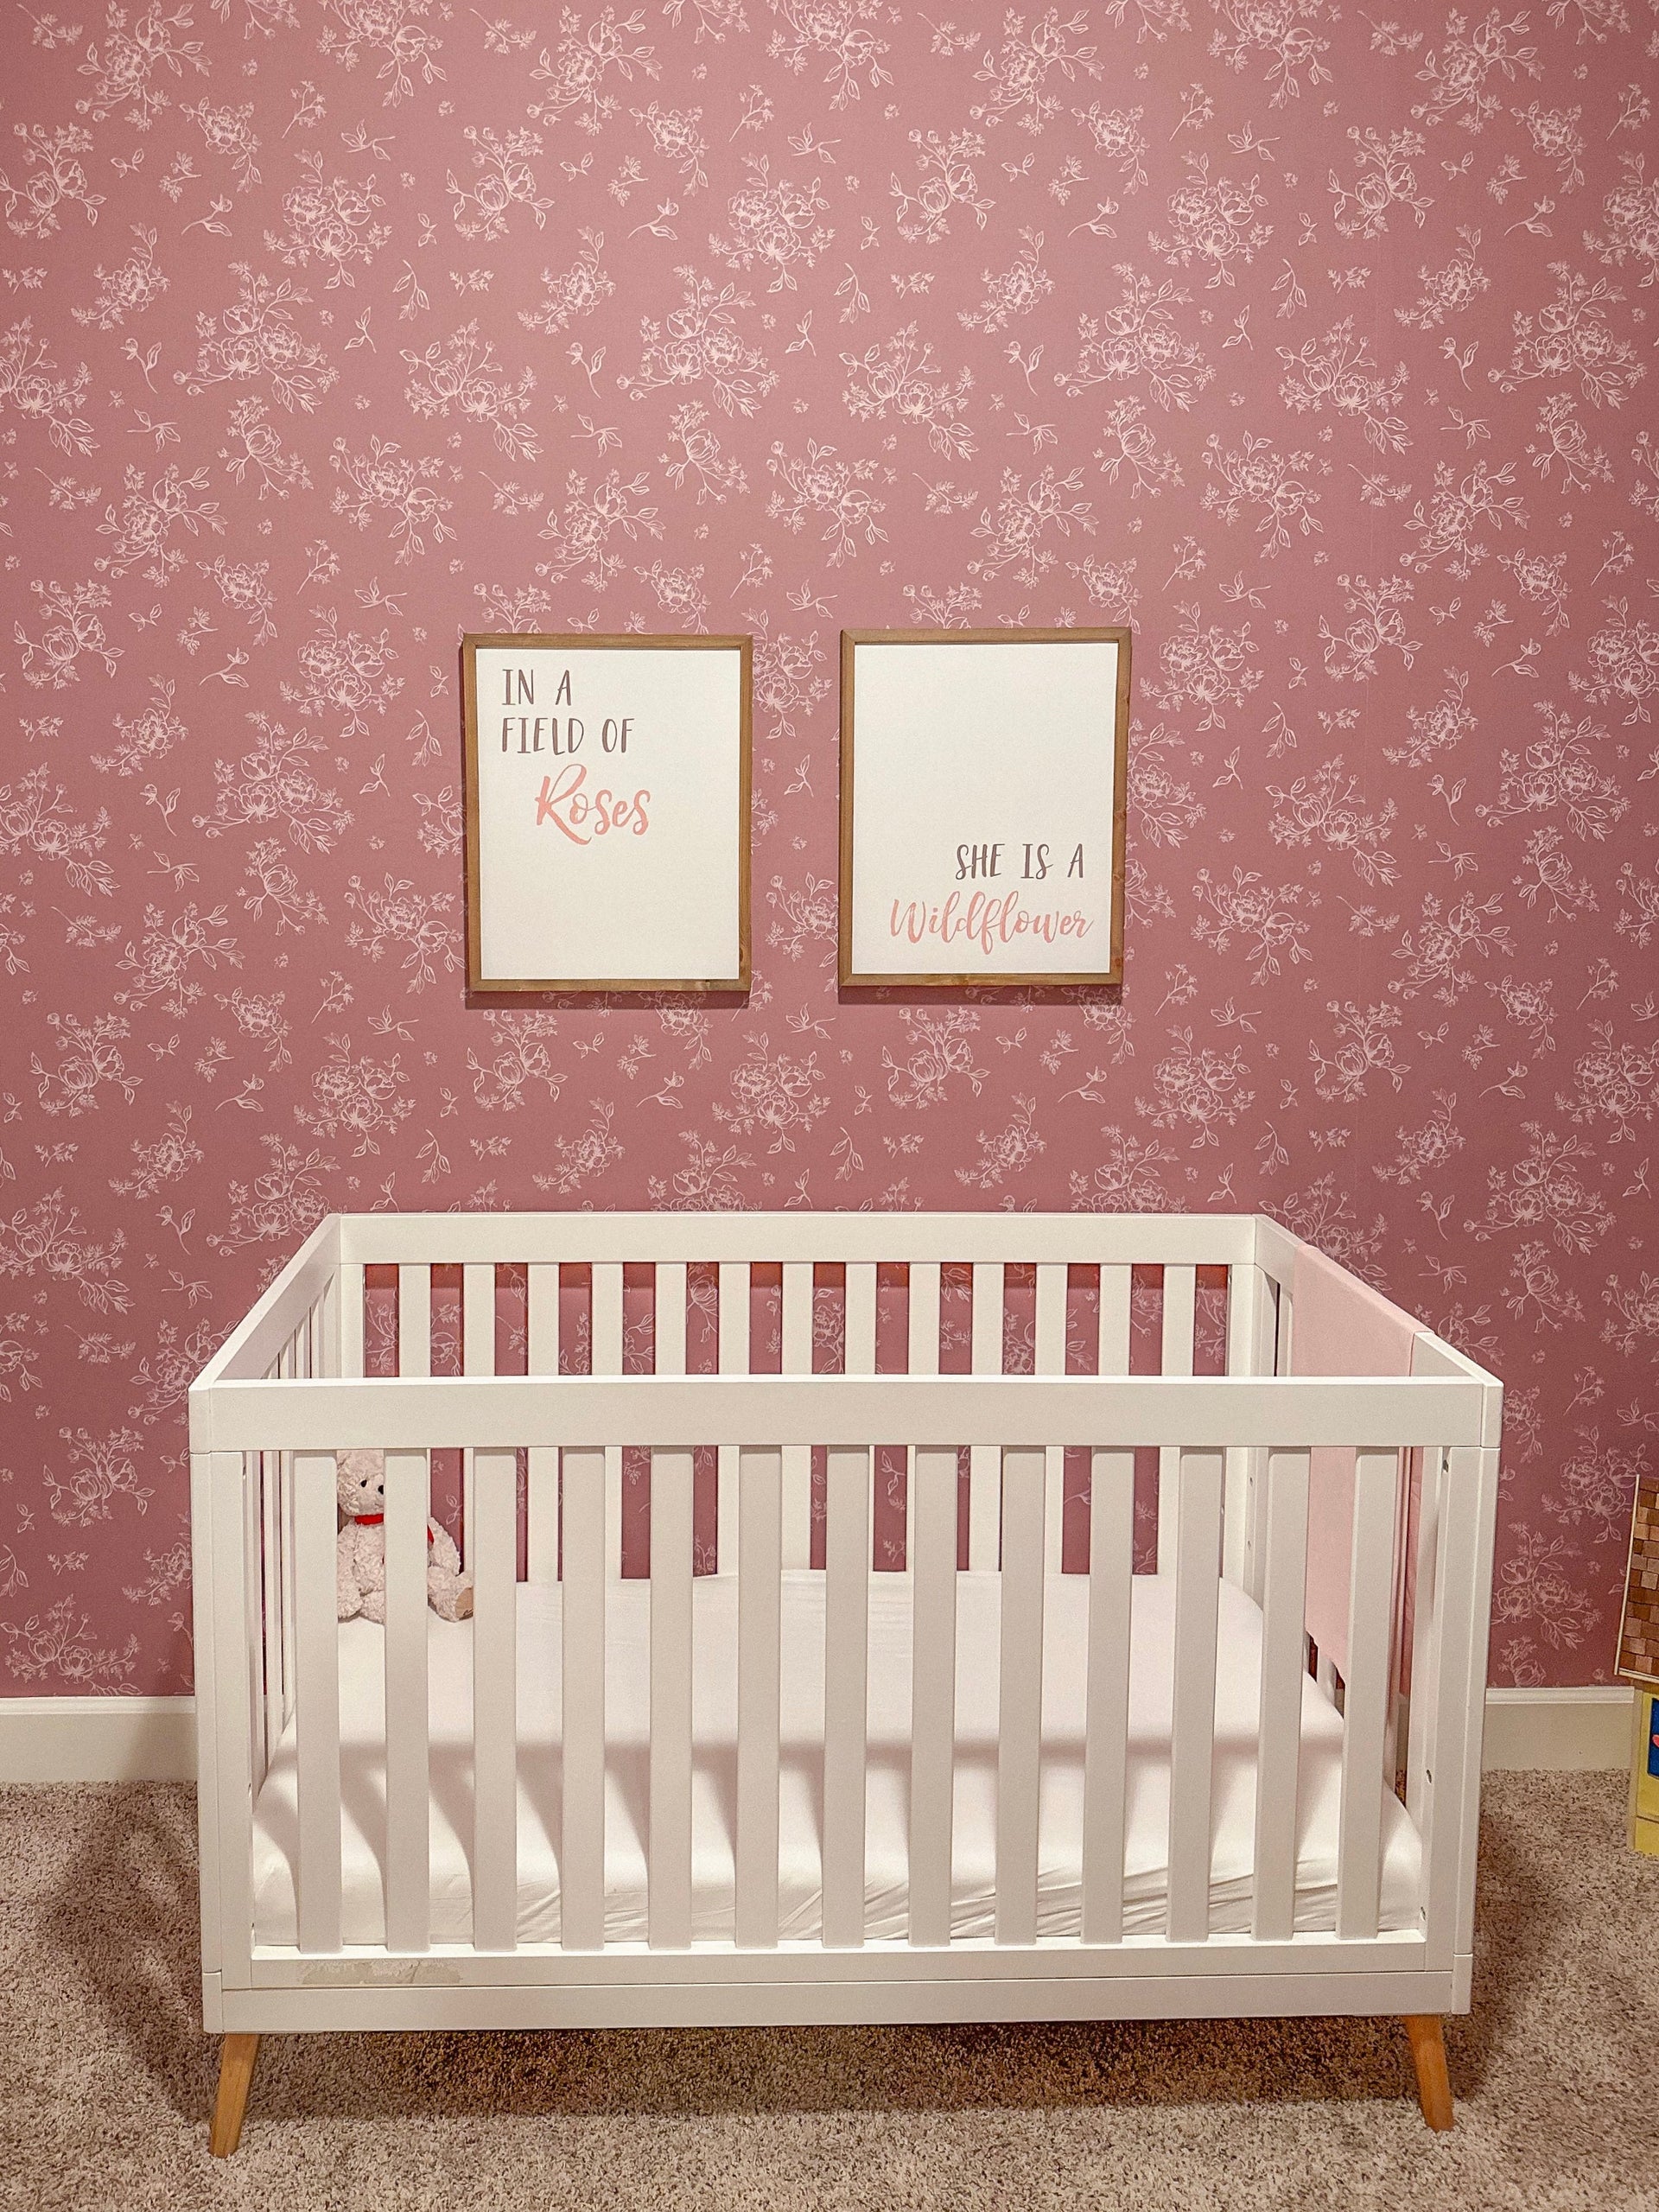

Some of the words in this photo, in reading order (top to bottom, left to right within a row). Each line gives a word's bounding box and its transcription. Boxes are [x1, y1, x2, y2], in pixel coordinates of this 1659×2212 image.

[501, 669, 535, 706] IN
[555, 669, 572, 706] A
[501, 716, 585, 756] FIELD
[601, 717, 635, 753] OF
[534, 763, 652, 846] Roses
[955, 842, 1006, 880] SHE
[1020, 843, 1054, 880] IS
[1066, 842, 1084, 879] A
[890, 890, 1095, 956] Wildflower
